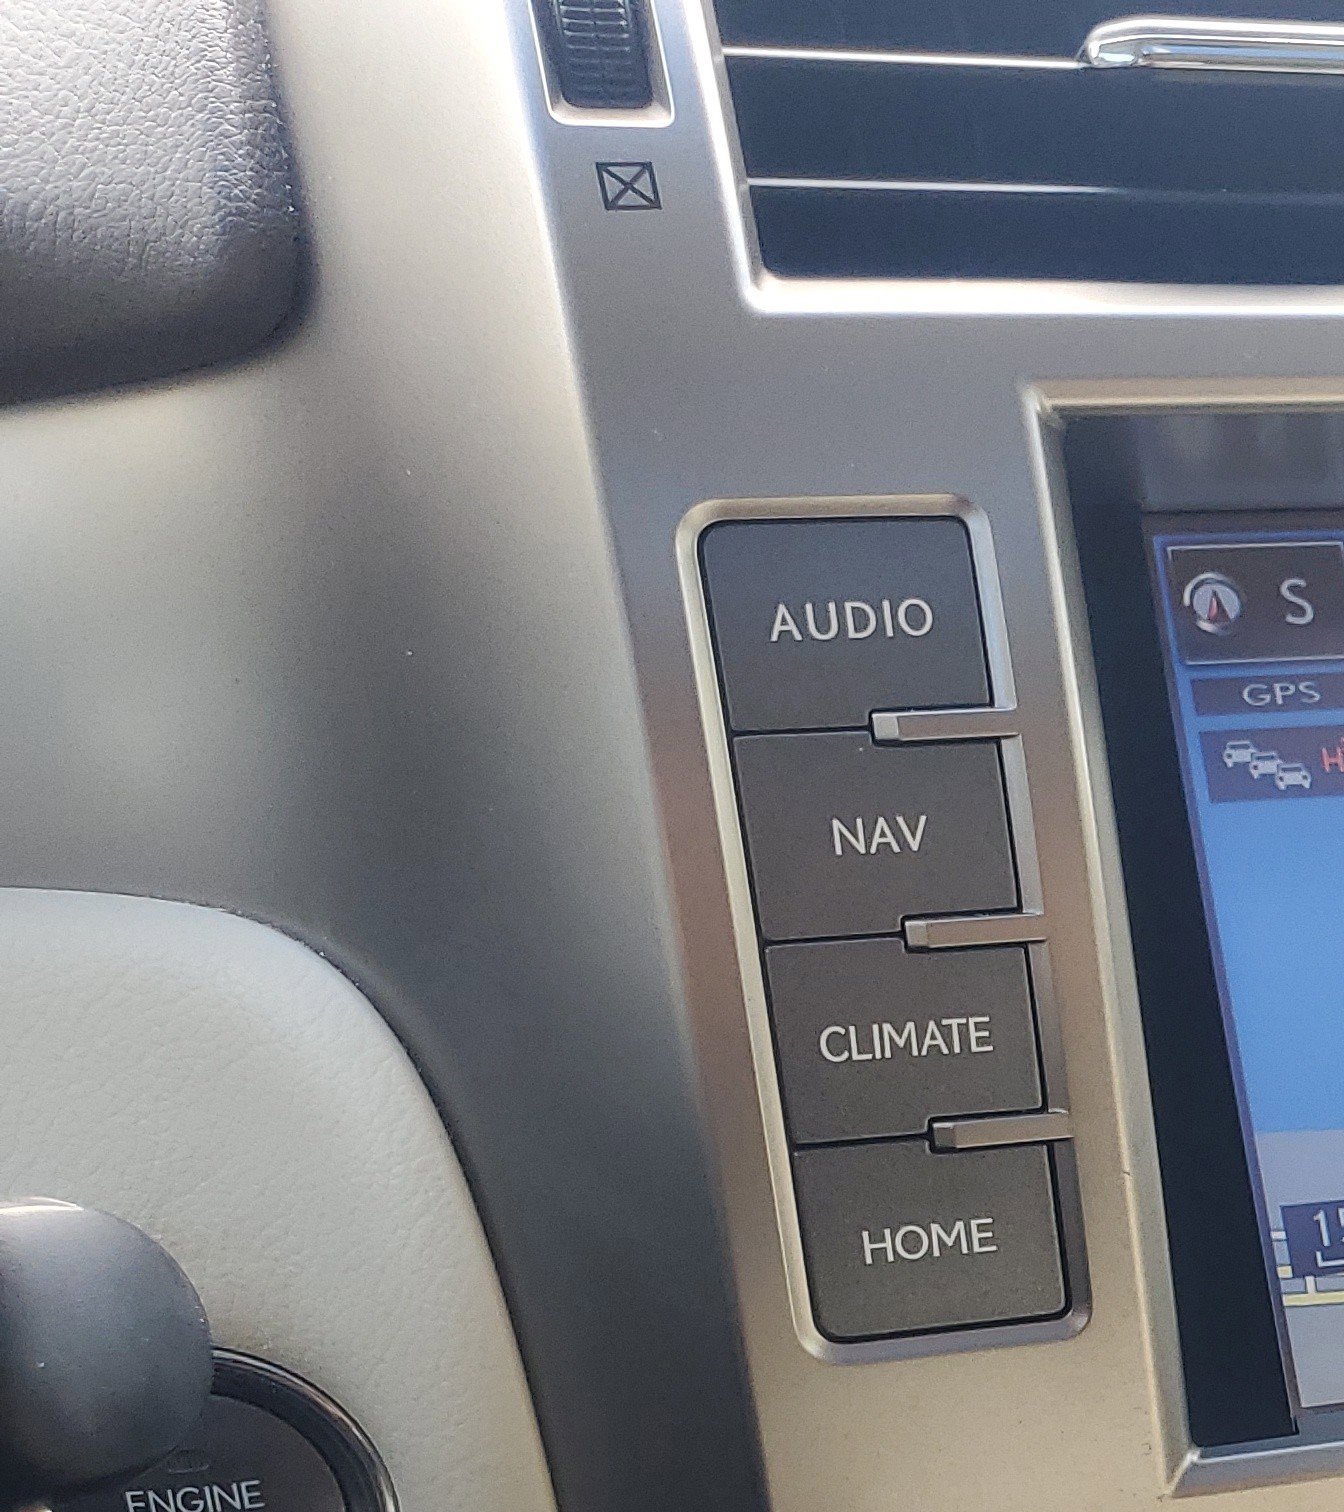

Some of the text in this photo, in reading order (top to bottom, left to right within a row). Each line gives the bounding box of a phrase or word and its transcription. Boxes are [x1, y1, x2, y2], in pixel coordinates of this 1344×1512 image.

[769, 597, 934, 643] AUDIO
[1283, 579, 1315, 626] S
[1242, 681, 1322, 707] GPS
[831, 814, 928, 856] NAV
[819, 1016, 995, 1063] CLIMATE
[862, 1217, 998, 1266] HOME
